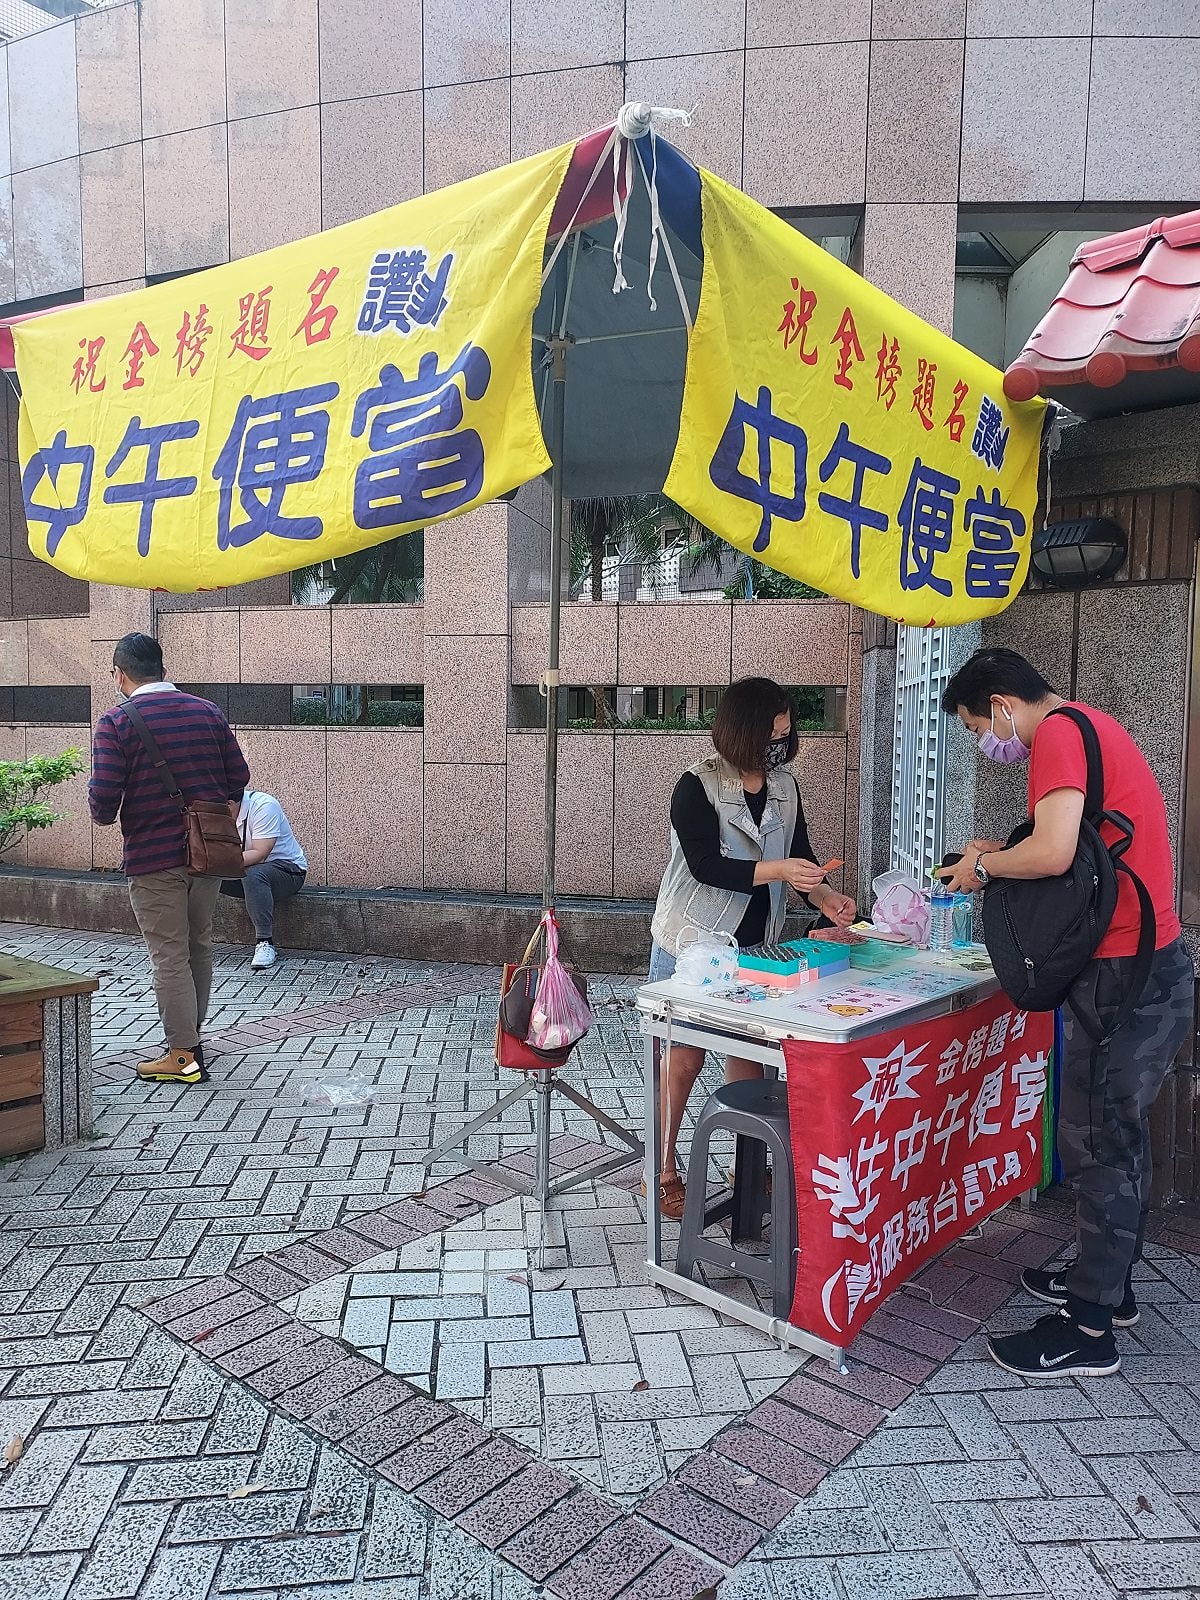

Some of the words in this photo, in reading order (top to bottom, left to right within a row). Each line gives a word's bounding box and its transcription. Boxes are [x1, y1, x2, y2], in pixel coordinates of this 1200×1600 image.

[70, 267, 340, 395] 祝金榜題名
[777, 278, 969, 443] 祝金榜題名
[21, 341, 491, 557] 中午便當
[709, 385, 1026, 598] 中午便當
[870, 1056, 903, 1104] 祝
[936, 1010, 1028, 1086] 金榜題名
